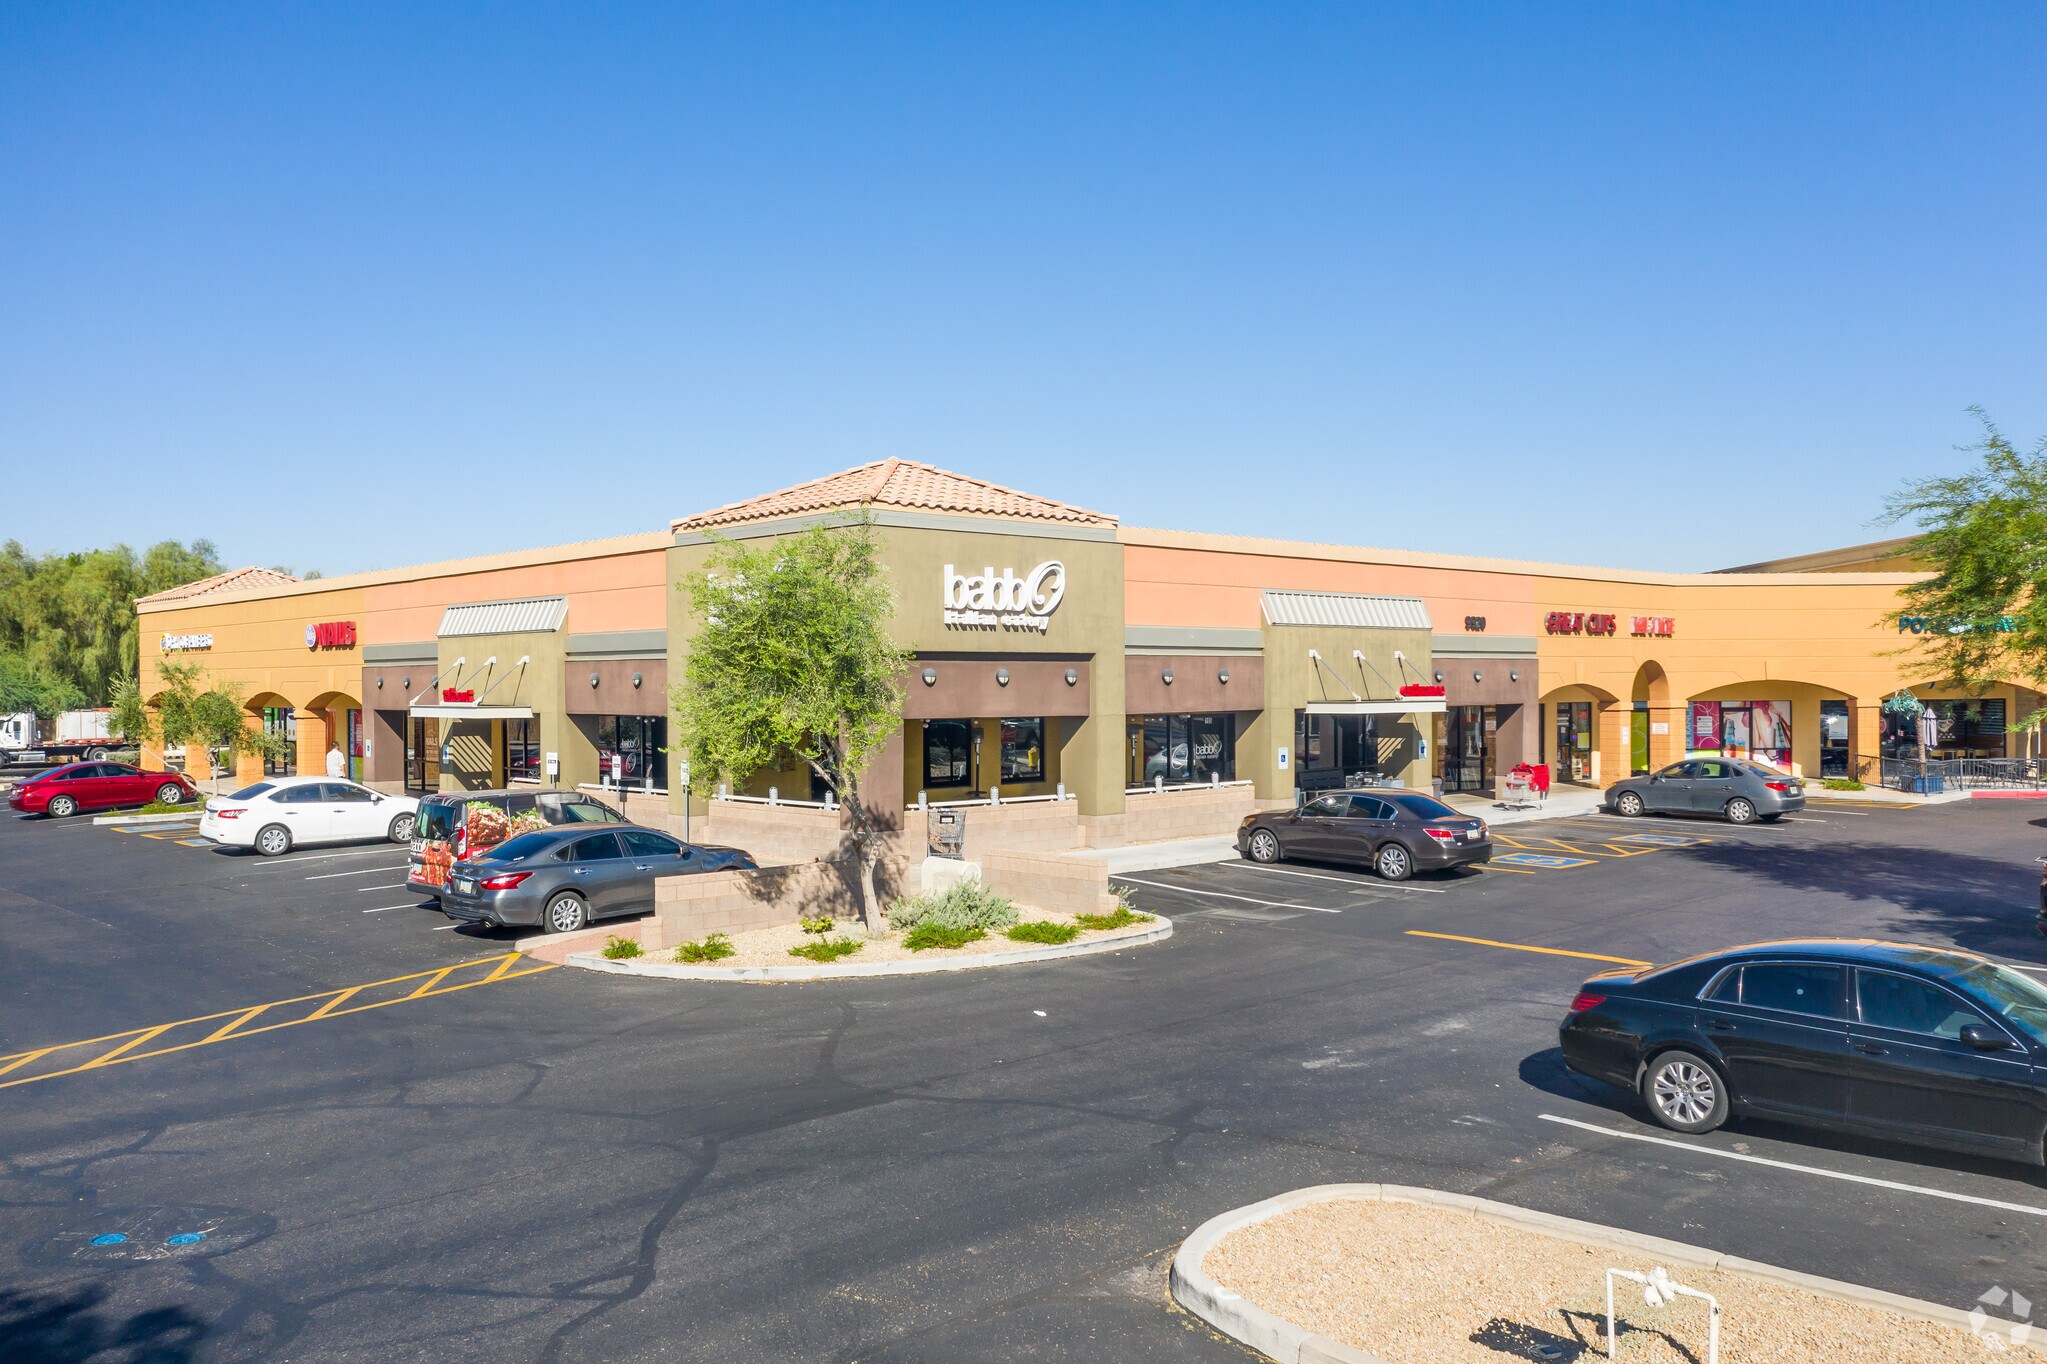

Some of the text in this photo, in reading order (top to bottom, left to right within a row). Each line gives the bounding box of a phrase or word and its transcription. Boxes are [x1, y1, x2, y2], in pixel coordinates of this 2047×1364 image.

[316, 621, 357, 647] NAILS
[1545, 611, 1585, 632] GREAT
[1585, 613, 1616, 634] CLIPS
